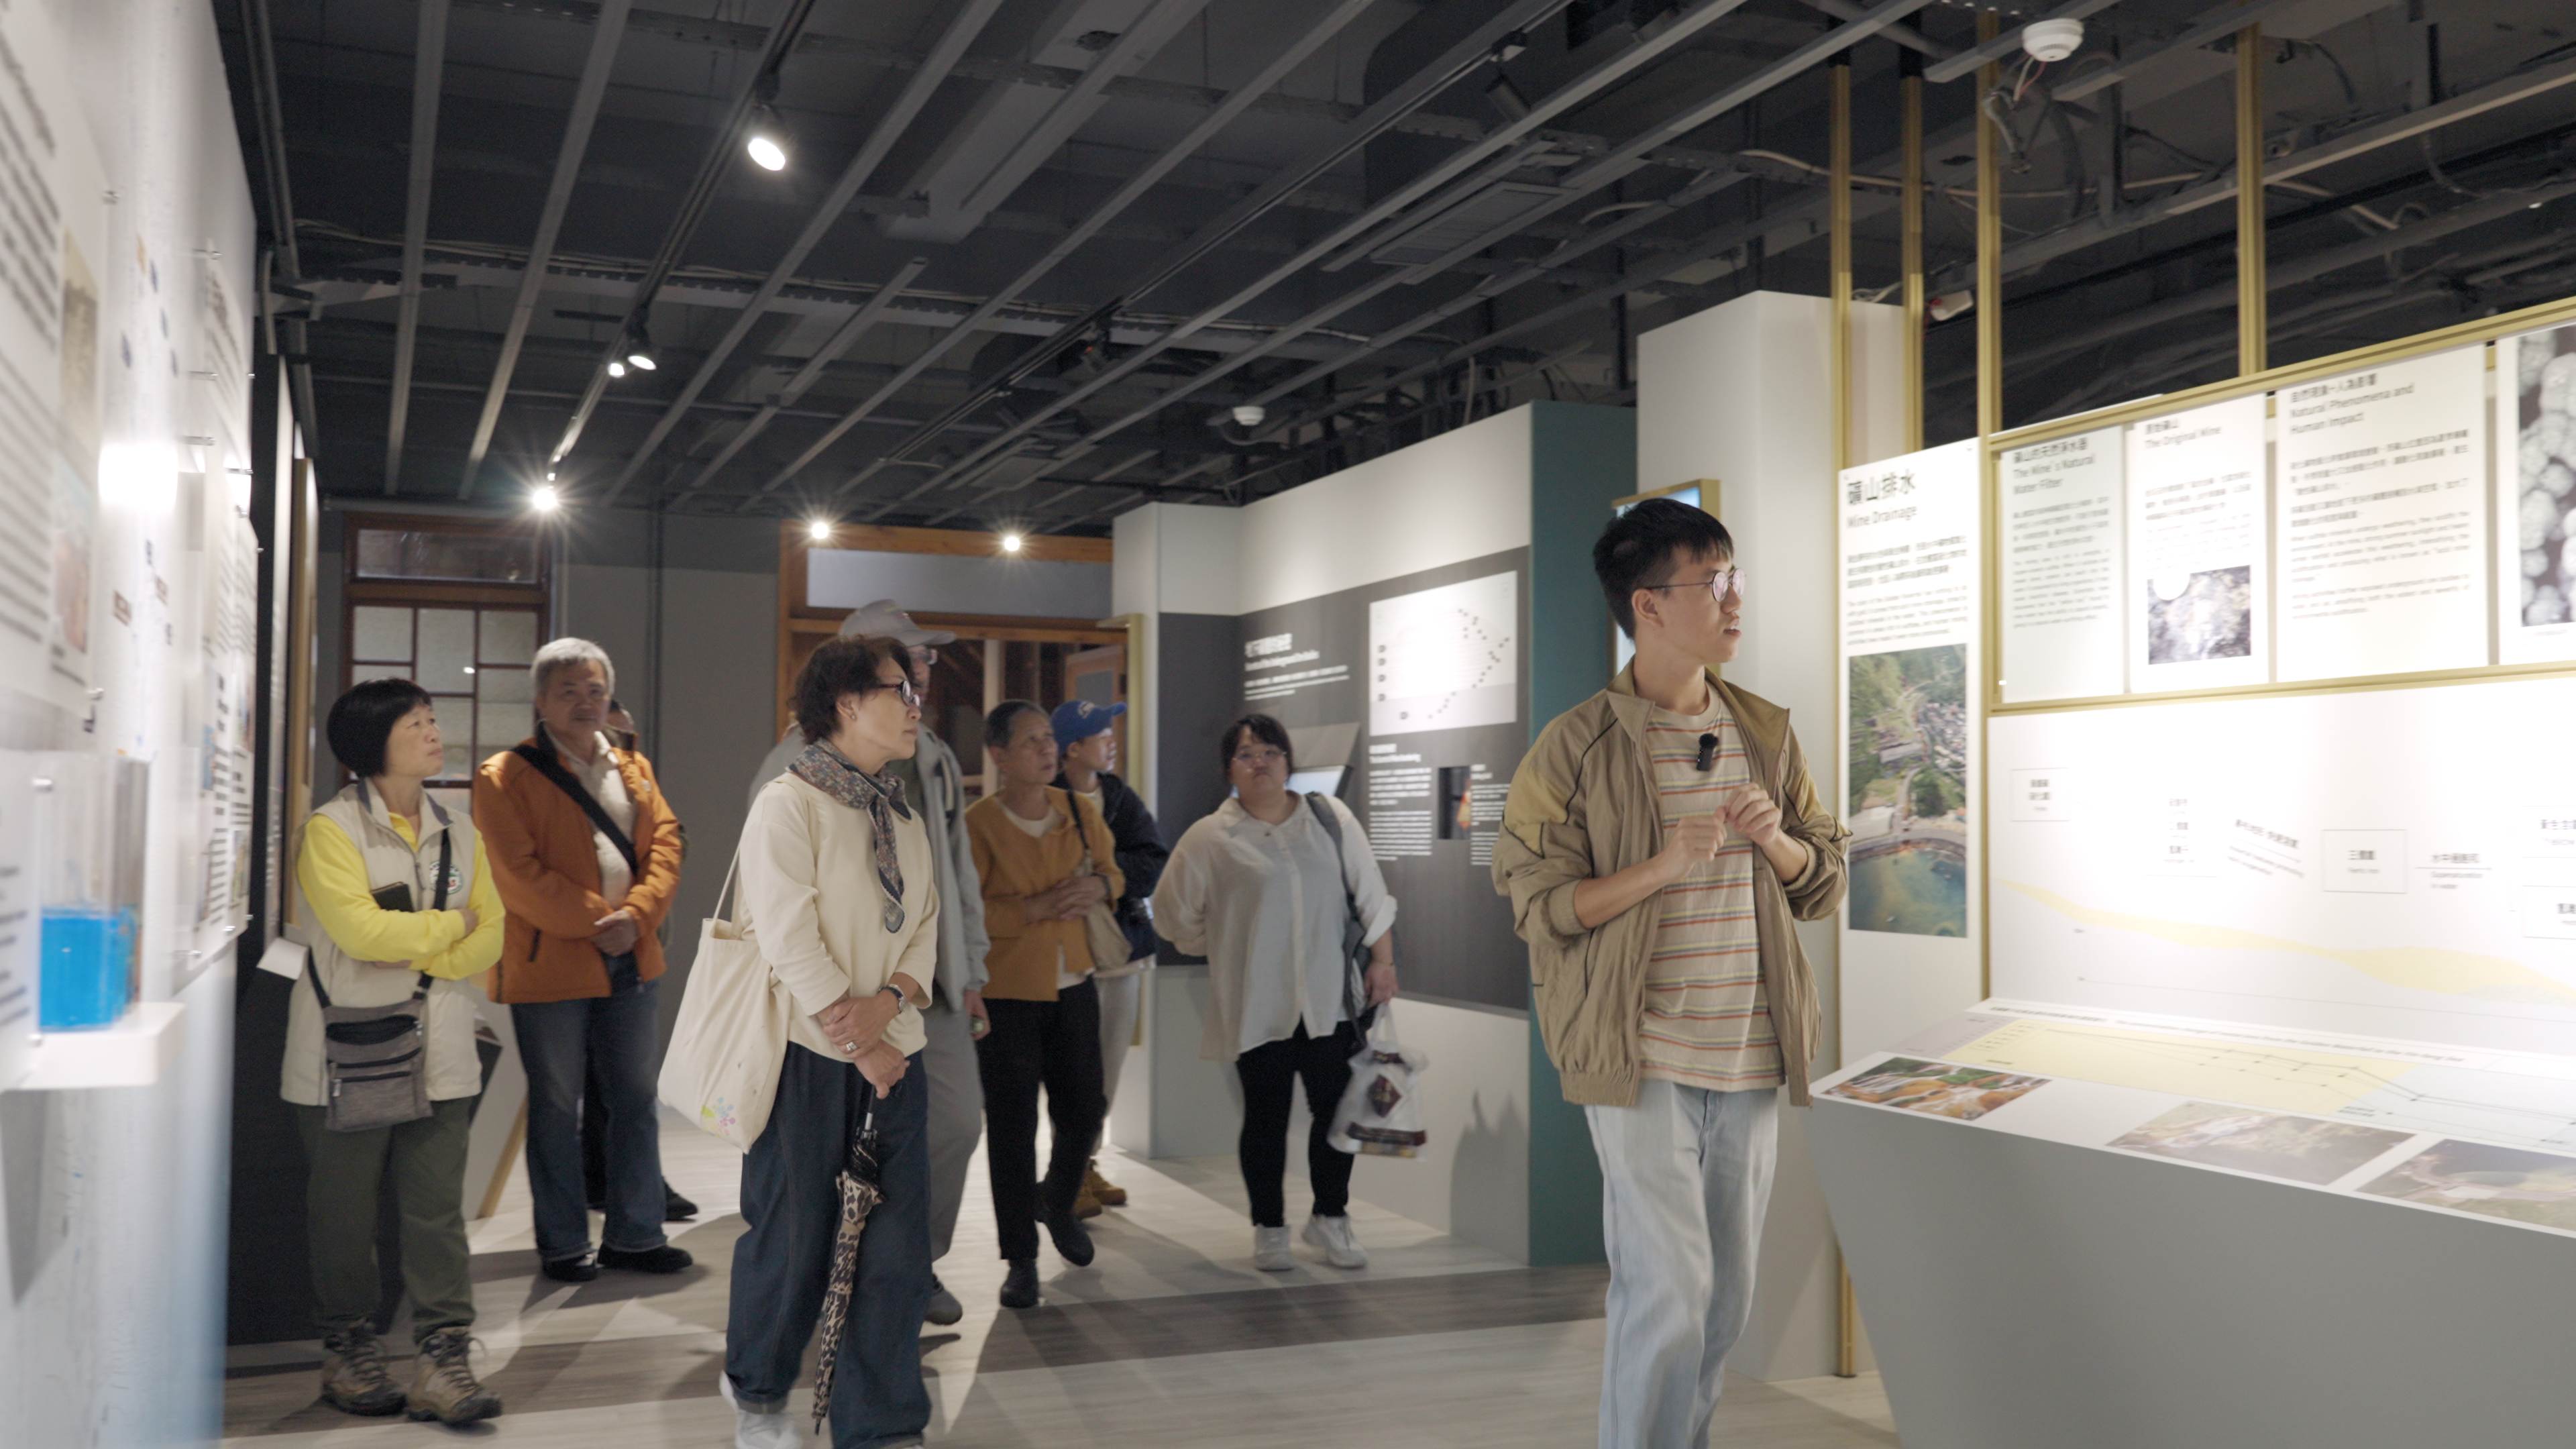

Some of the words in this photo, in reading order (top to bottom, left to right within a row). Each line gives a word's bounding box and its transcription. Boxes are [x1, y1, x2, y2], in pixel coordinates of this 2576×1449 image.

[2291, 404, 2326, 417] Natural
[2328, 389, 2392, 409] Phenomena
[2394, 382, 2415, 396] and
[2328, 412, 2365, 428] Impact
[1847, 468, 1917, 506] 礦山排水
[1873, 506, 1919, 524] Drainage
